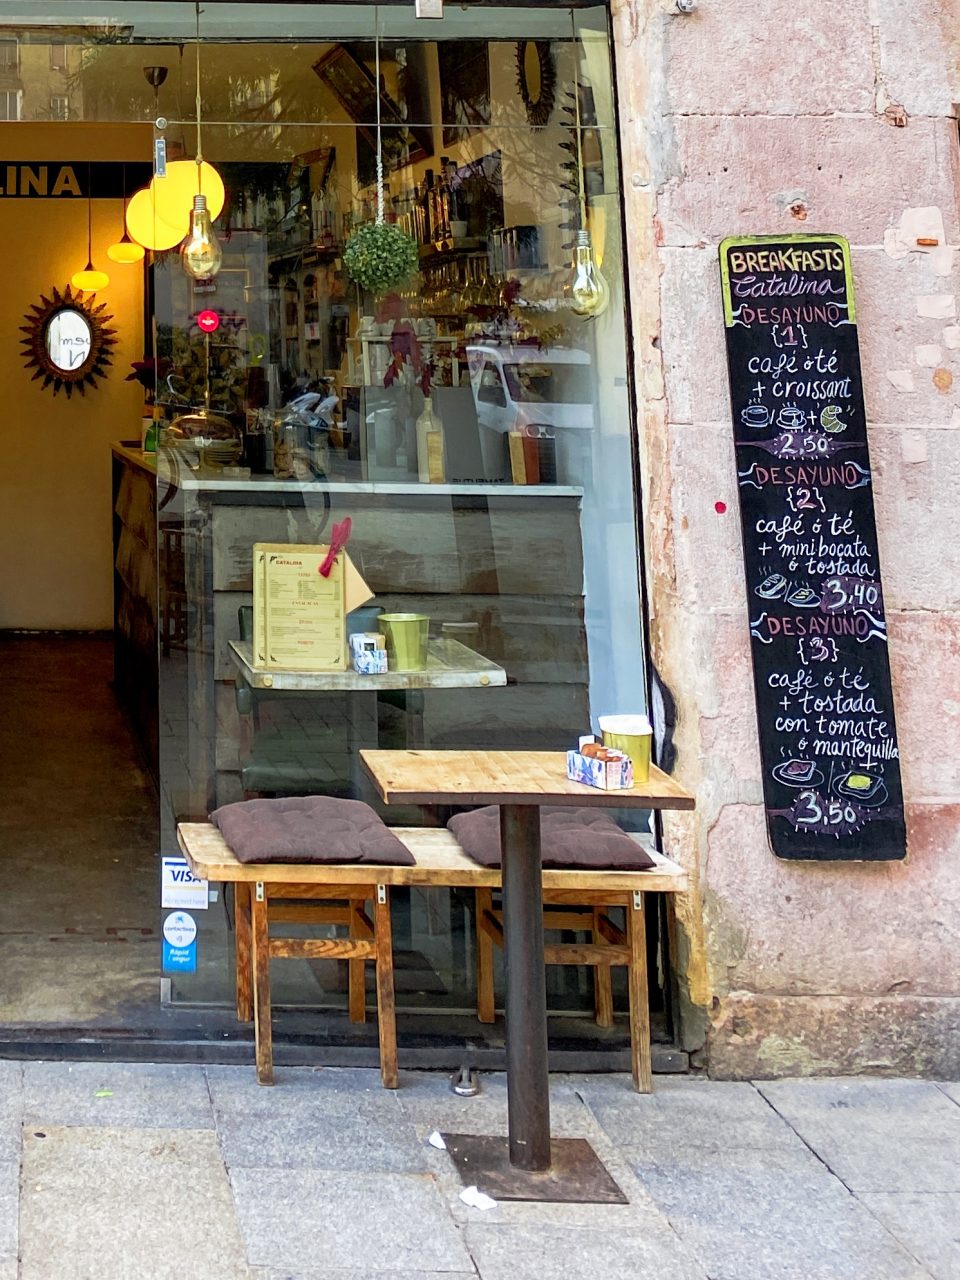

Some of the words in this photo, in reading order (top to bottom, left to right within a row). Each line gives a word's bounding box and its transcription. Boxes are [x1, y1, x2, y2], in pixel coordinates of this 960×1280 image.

[729, 248, 844, 274] BREAKFASTS
[731, 273, 846, 298] Catalina
[742, 305, 840, 324] DESAYUNO
[748, 349, 799, 379] café
[814, 348, 839, 374] té
[772, 376, 852, 400] croissant
[780, 433, 829, 456] 2,50
[755, 465, 857, 487] DESAYUNO
[755, 513, 805, 543] café
[827, 509, 855, 536] té
[804, 557, 877, 577] tostada
[827, 579, 878, 610] 3,40
[766, 615, 869, 637] DESAYUNO
[768, 669, 819, 696] café
[838, 666, 870, 691] té
[798, 689, 885, 714] tostada
[775, 716, 811, 733] con
[815, 715, 889, 740] tomate
[812, 736, 900, 769] mantequilla
[797, 790, 857, 826] 3,50
